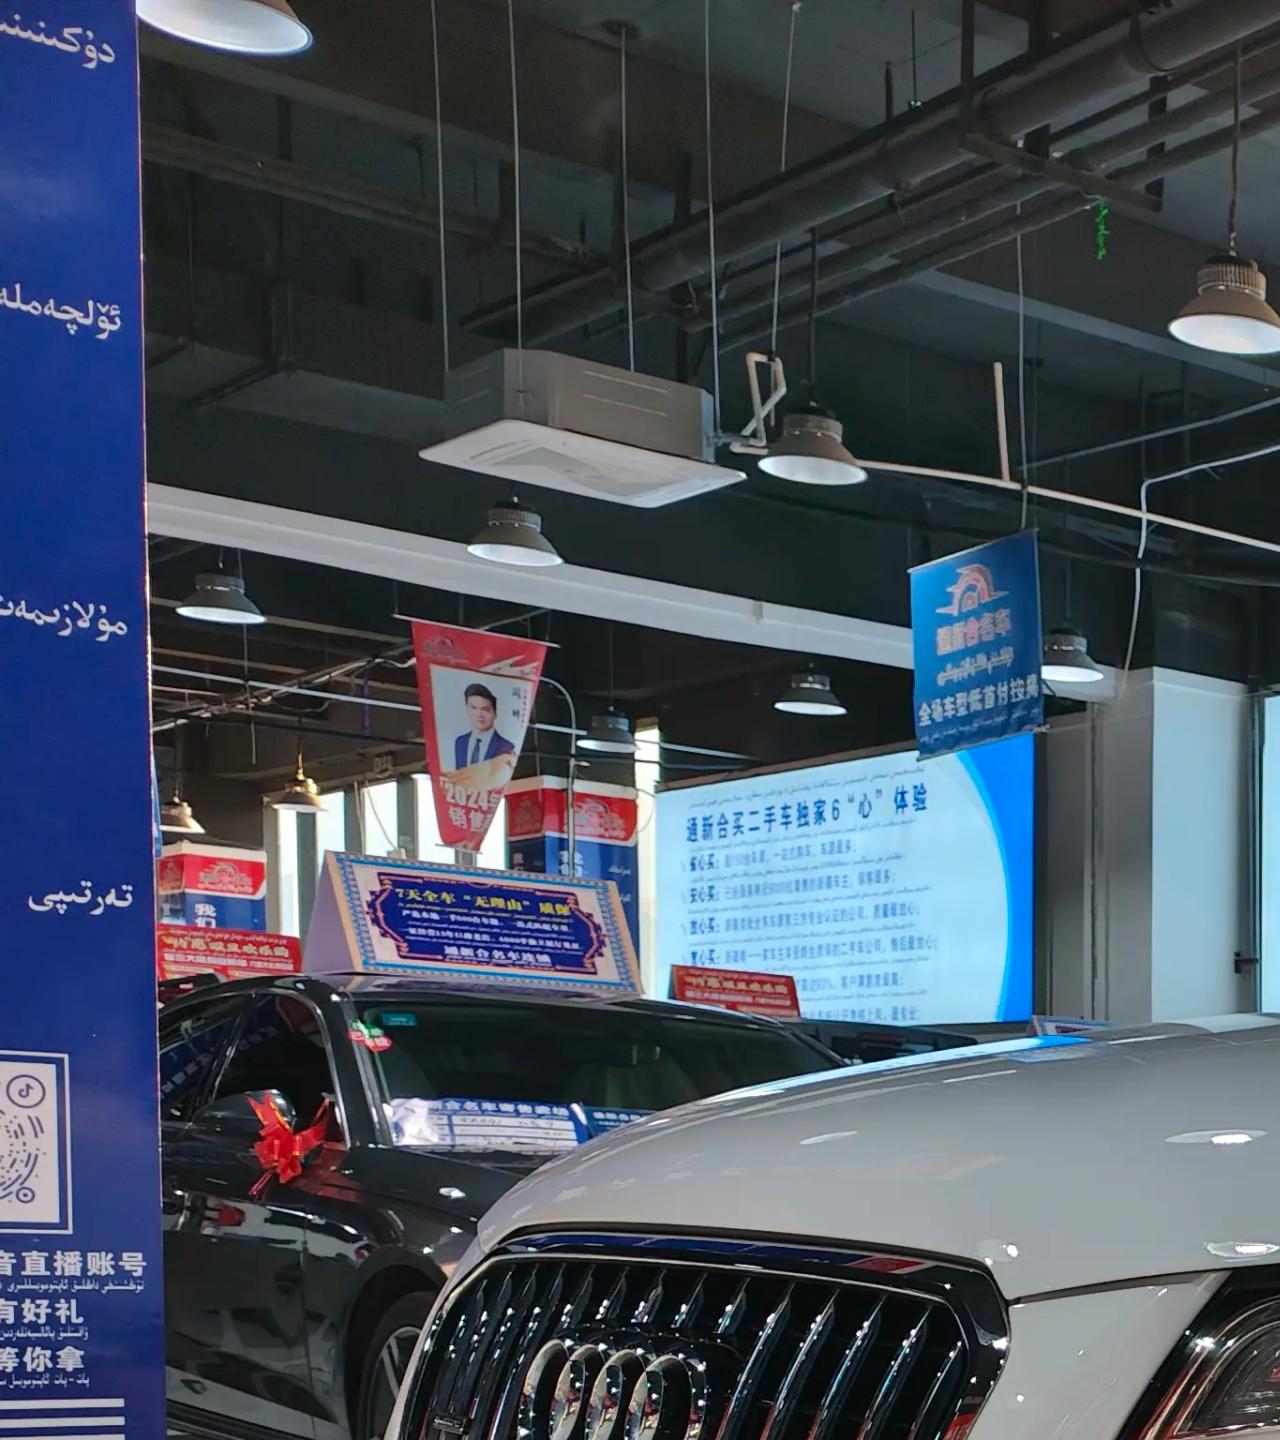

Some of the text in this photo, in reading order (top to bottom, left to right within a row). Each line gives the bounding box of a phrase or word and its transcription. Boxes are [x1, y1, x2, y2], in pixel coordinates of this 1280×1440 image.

[0, 1298, 85, 1325] 有好礼
[0, 1345, 85, 1373] 等你拿
